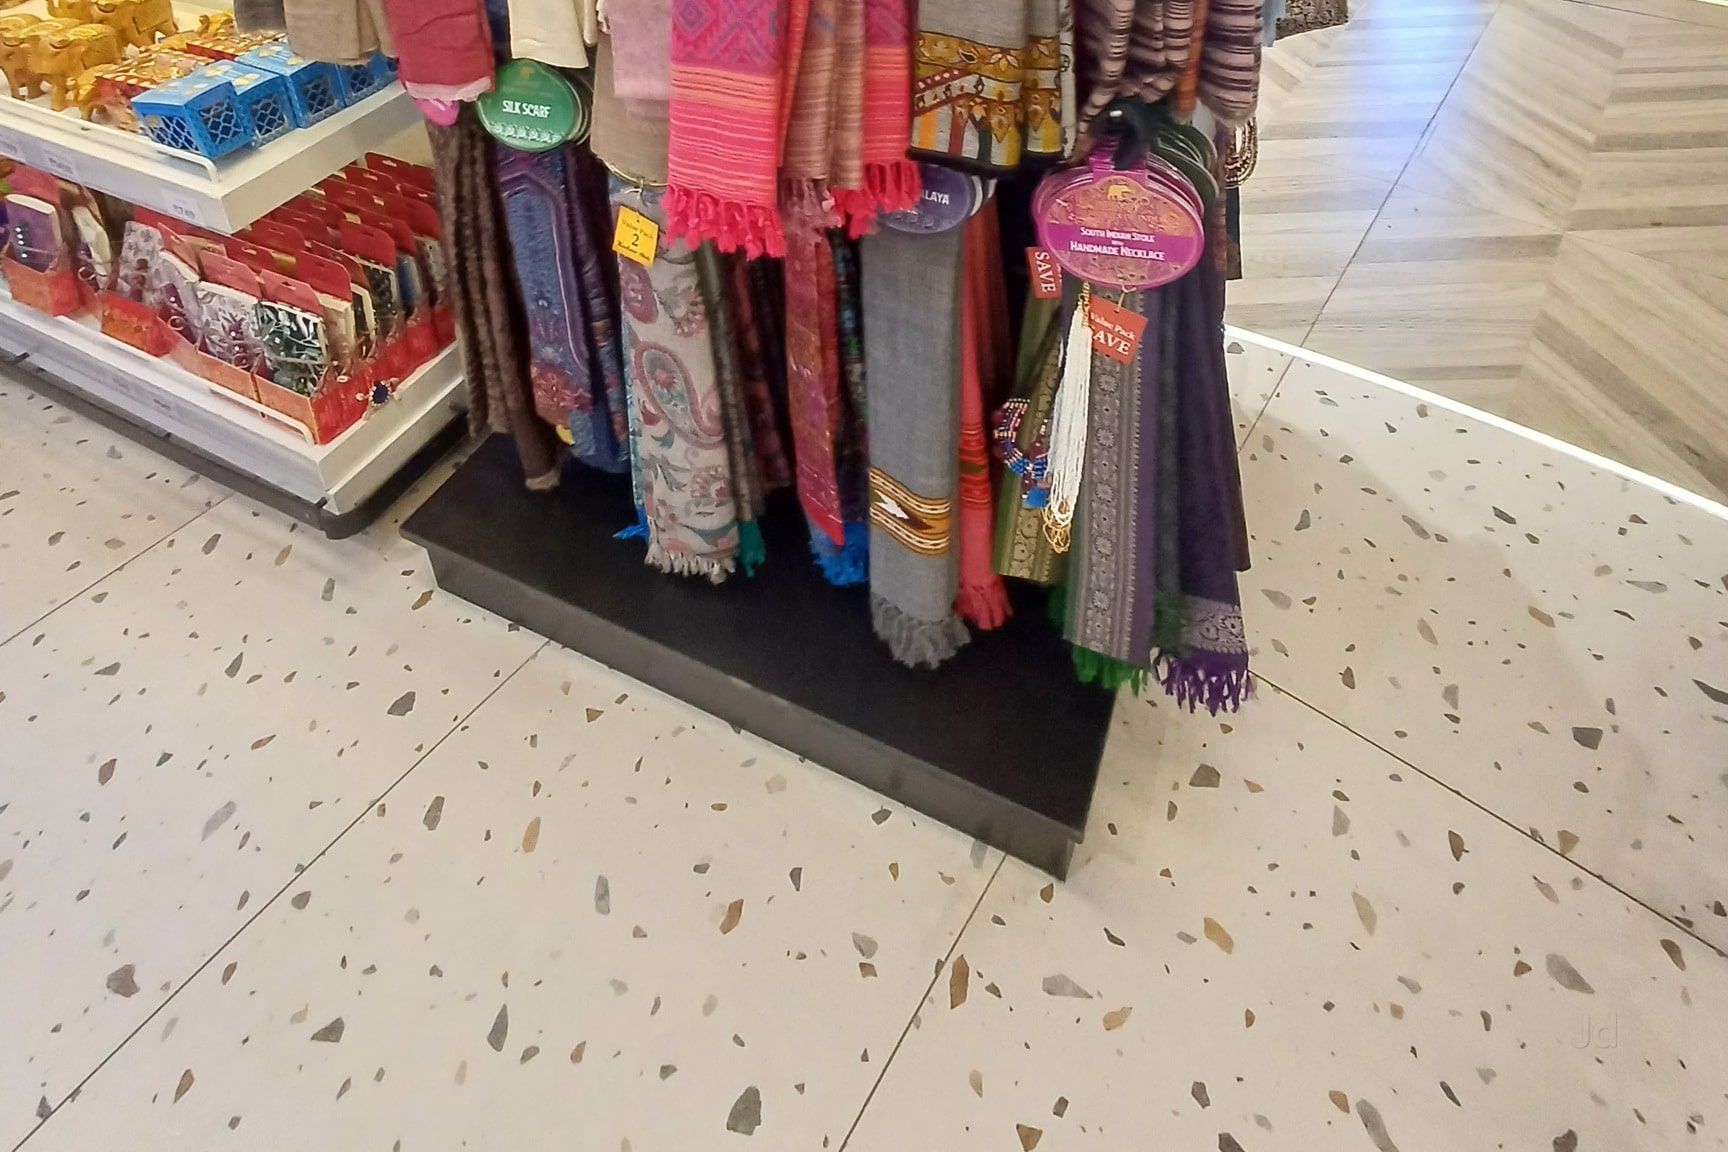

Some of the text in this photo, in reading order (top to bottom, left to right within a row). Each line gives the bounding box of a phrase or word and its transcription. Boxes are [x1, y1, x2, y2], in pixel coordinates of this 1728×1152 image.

[502, 99, 551, 118] SILK SCARF
[921, 190, 950, 205] LAYA
[631, 233, 640, 247] 2
[1080, 227, 1155, 243] SOUTH INDIAN STOLE
[1070, 241, 1165, 261] HANDMADE NECKLACE
[1034, 251, 1056, 293] SAVE
[1090, 311, 1136, 341] Value Pack
[1091, 328, 1132, 356] AVE
